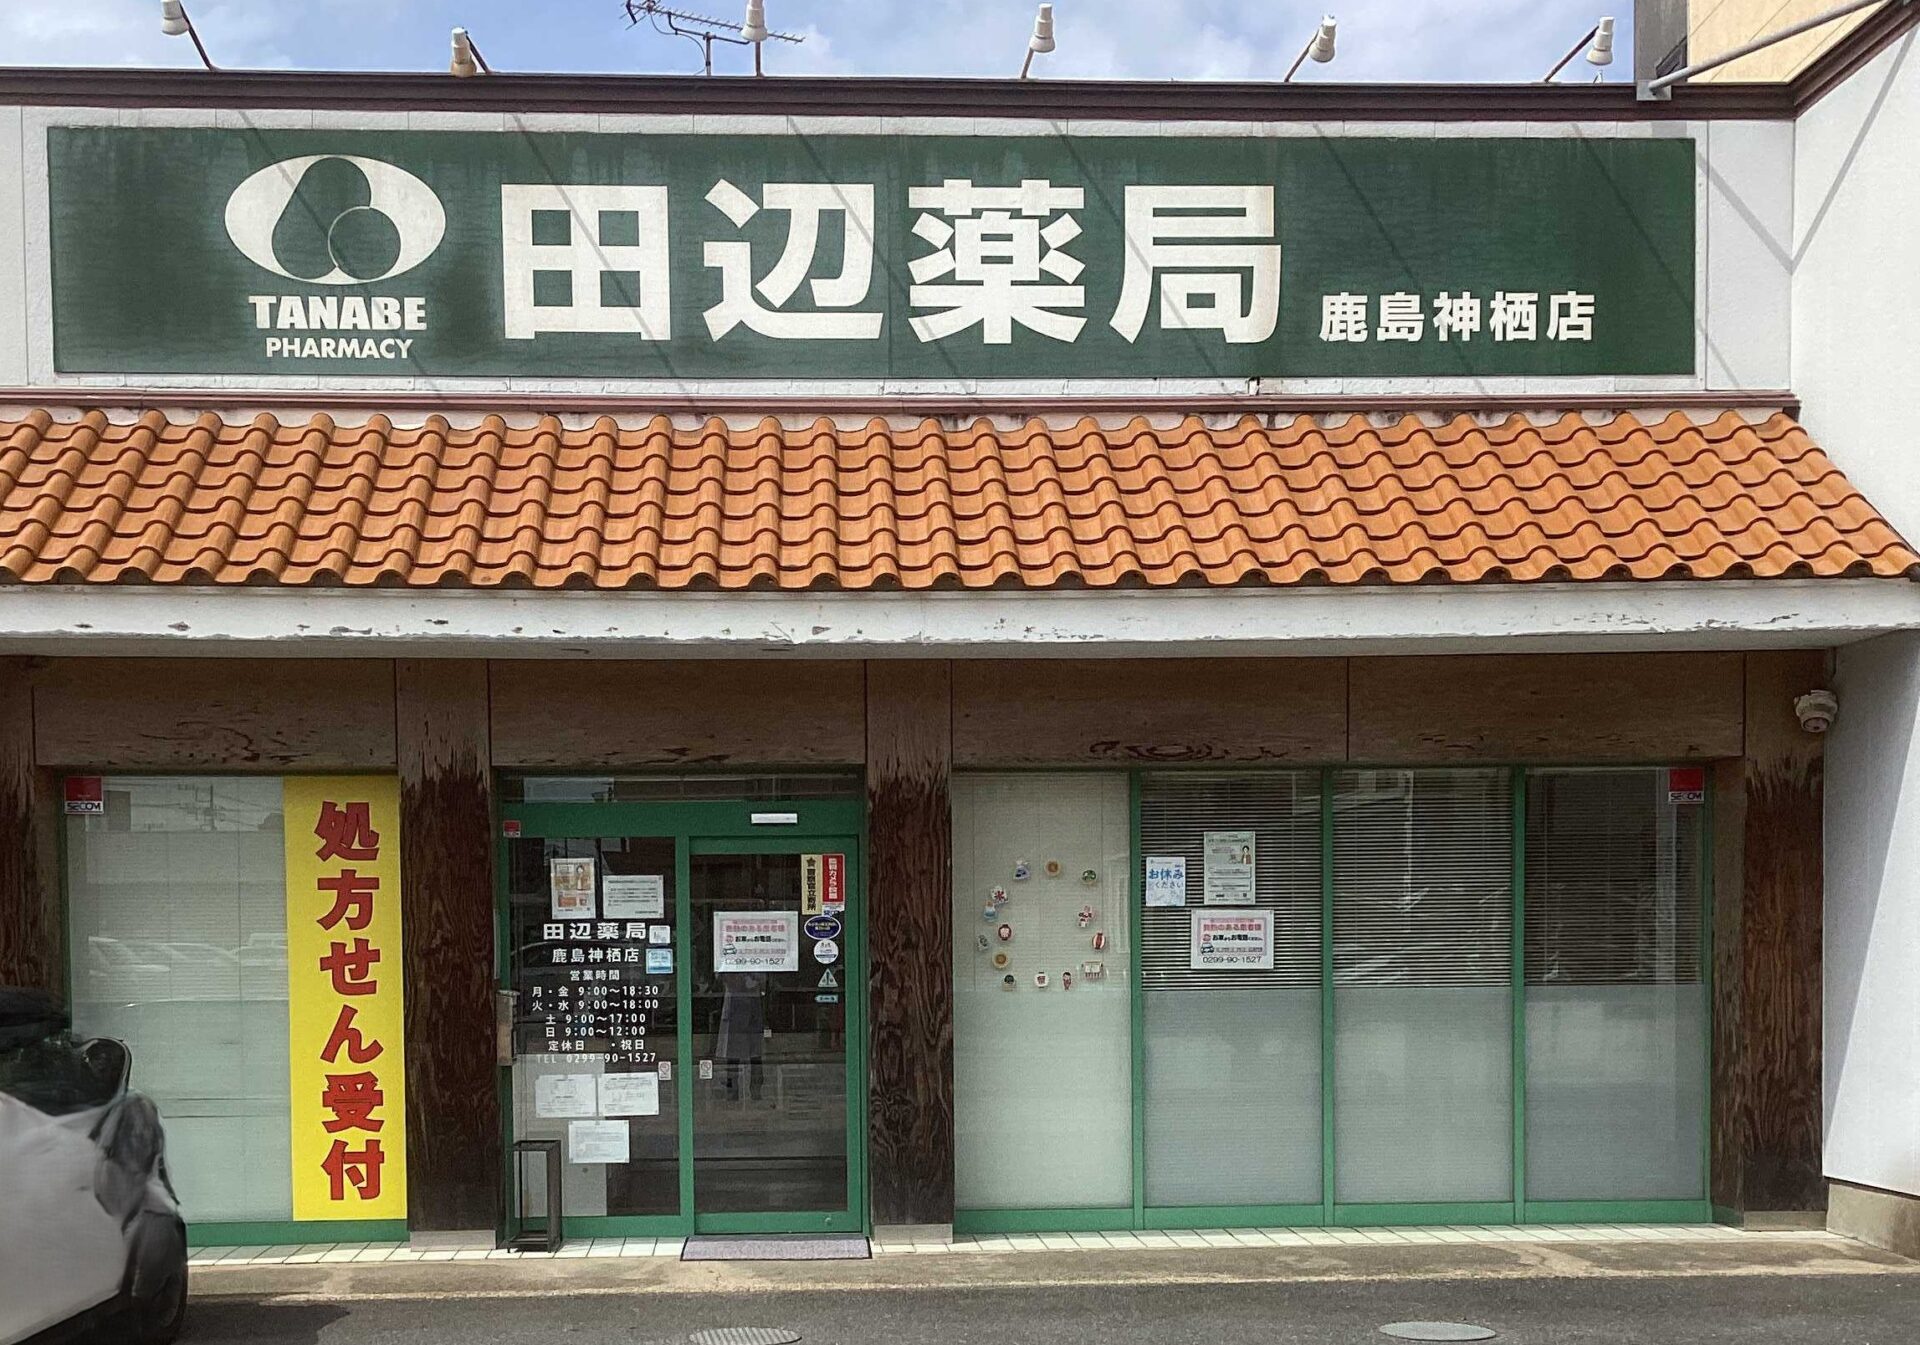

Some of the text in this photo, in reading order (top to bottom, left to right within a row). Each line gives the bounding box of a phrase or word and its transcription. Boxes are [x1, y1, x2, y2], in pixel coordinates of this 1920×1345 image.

[501, 178, 1282, 344] 田辺薬局
[248, 295, 427, 331] TANABE
[1319, 291, 1595, 342] 鹿島神栖店
[266, 337, 413, 359] PHARMACY
[1148, 868, 1185, 881] お休み
[543, 922, 646, 940] 田辺薬局
[552, 948, 639, 963] 鹿島神栖店
[569, 969, 620, 981] 営業時間
[532, 986, 569, 998] 月・金
[314, 801, 384, 1201] 処方せん受付
[532, 1000, 569, 1012] 火・水
[545, 1014, 556, 1025] 土
[545, 1027, 555, 1037] 日
[548, 1040, 585, 1051] 定休日
[536, 1052, 656, 1063] TEL 0299-90-1527
